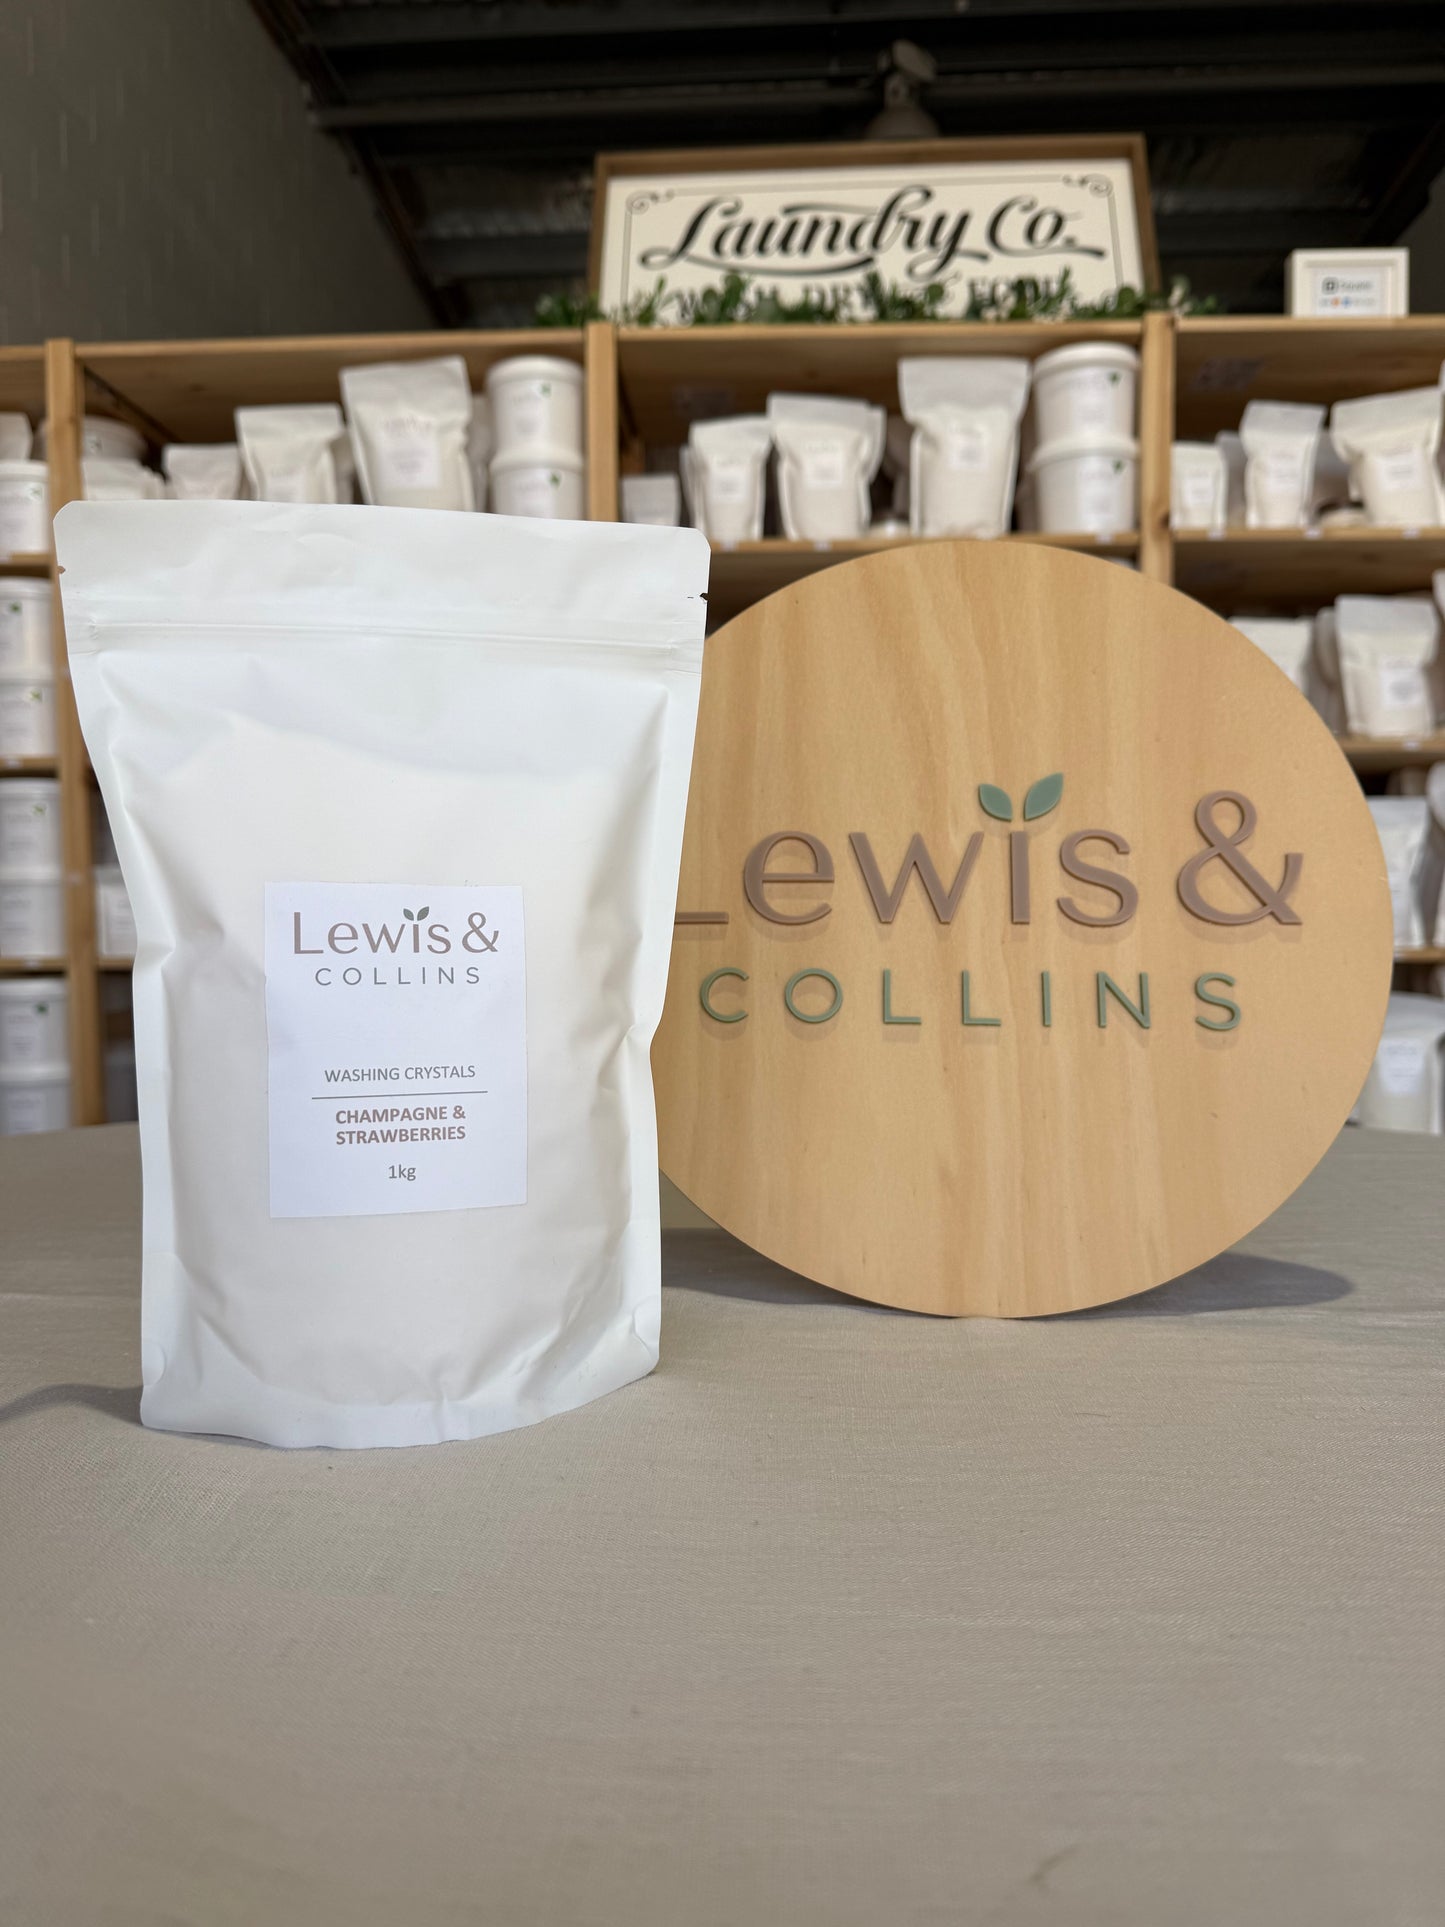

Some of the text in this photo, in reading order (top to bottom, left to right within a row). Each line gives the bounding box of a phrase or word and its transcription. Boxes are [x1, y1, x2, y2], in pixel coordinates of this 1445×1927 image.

[639, 184, 989, 280] Laundry
[674, 790, 1305, 928] ewis &
[293, 908, 500, 955] Lewis &
[315, 966, 481, 986] COLLINS
[699, 966, 1243, 1032] COLLINS
[324, 1066, 476, 1082] WASHING CRYSTALS
[335, 1105, 466, 1124] CHAMPAGNE &
[335, 1127, 466, 1145] STRAWBERRIES
[388, 1165, 416, 1181] 1kg
